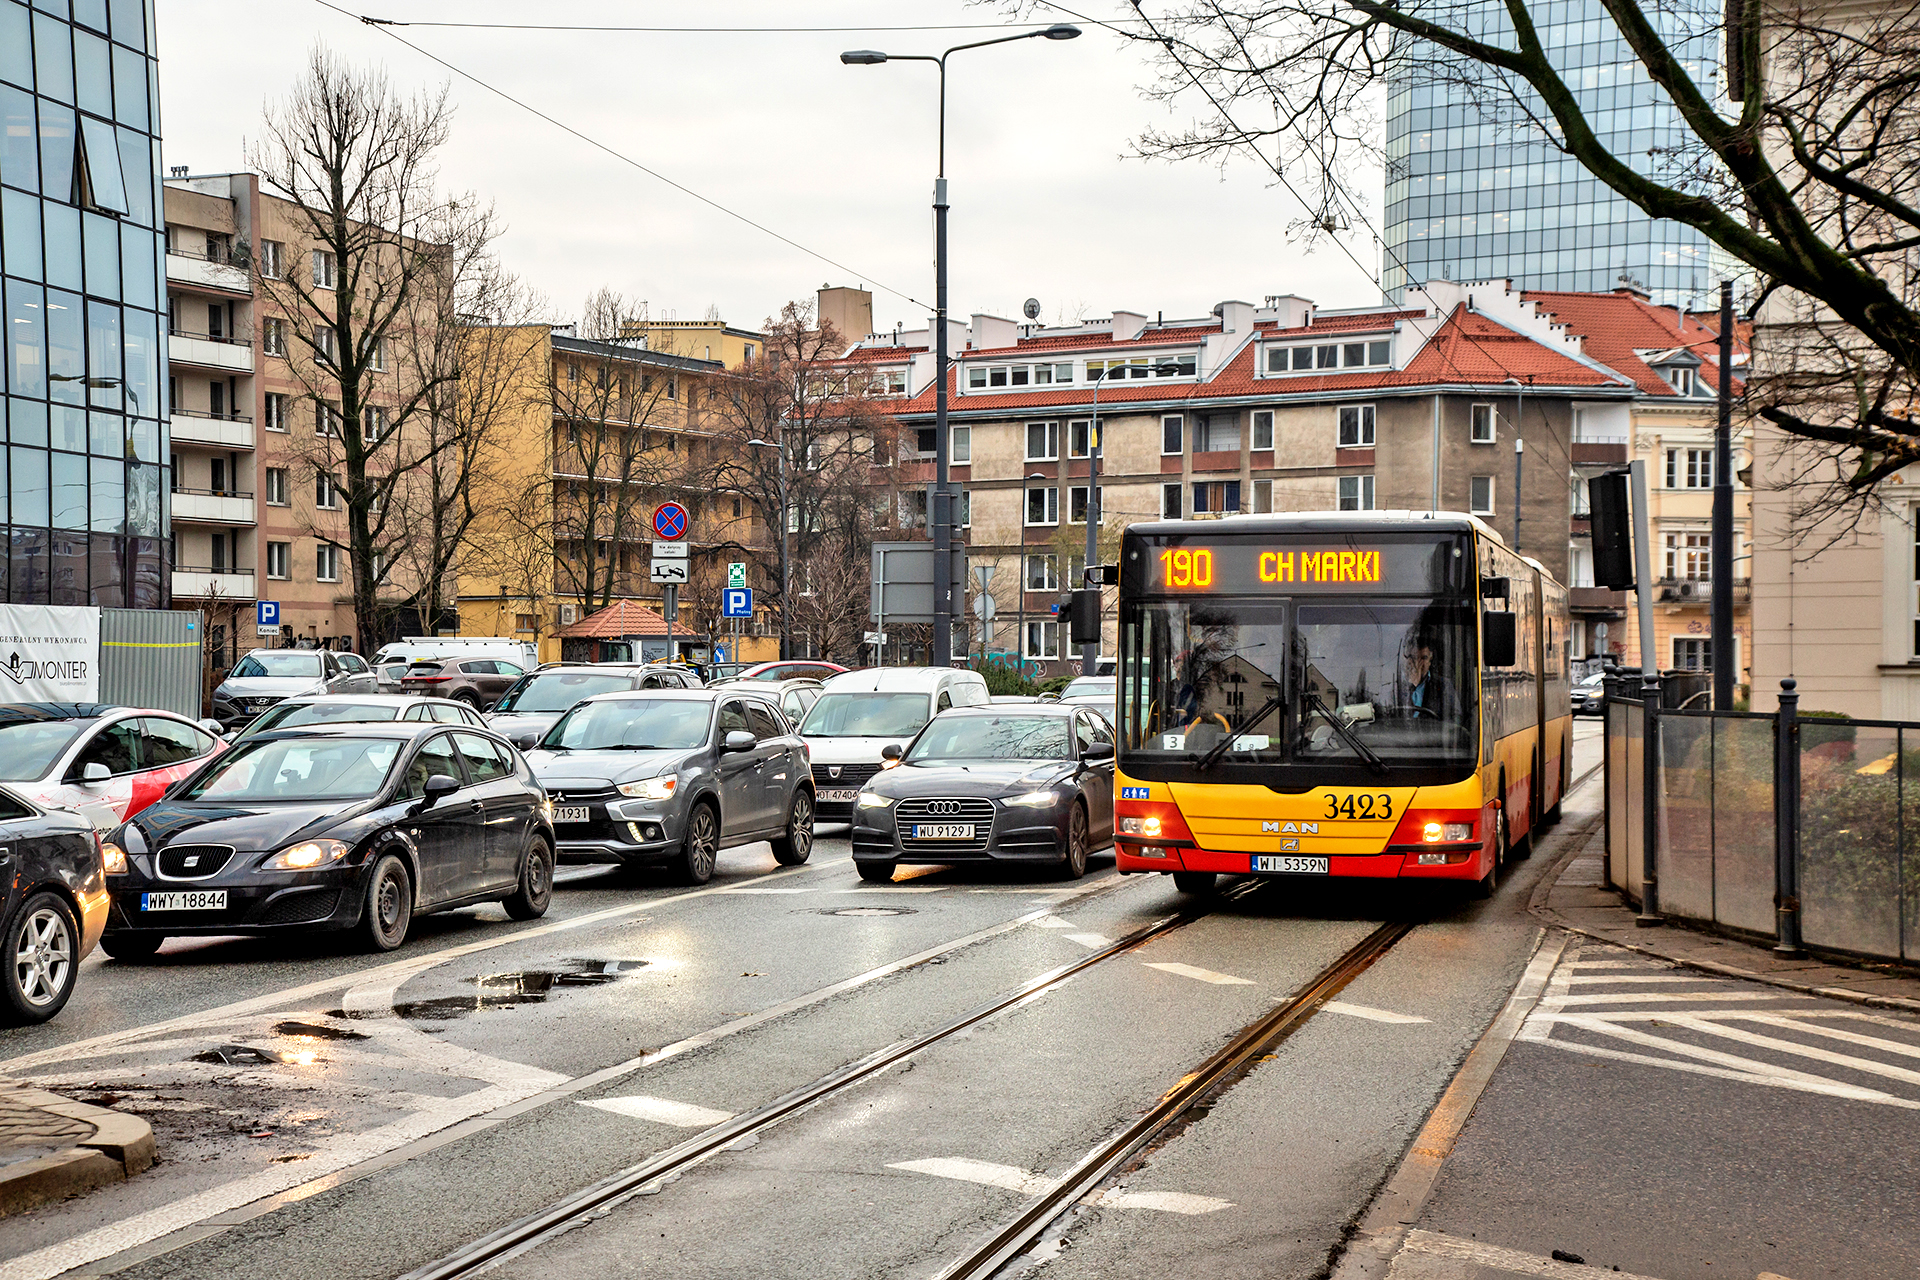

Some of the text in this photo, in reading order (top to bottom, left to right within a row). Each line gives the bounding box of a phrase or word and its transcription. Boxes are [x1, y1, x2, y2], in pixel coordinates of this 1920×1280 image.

[1159, 549, 1212, 586] 190
[1259, 551, 1380, 582] CH MARKI
[729, 591, 746, 614] P
[262, 603, 275, 622] P
[259, 626, 278, 634] Koniec
[0, 635, 88, 645] GENERALNY WYKONAWCA
[33, 661, 88, 680] MONTER
[1169, 736, 1178, 749] 3
[553, 807, 587, 819] 71931
[1323, 793, 1393, 820] 3423
[919, 825, 971, 837] WU 9129J
[1261, 821, 1319, 834] MAN
[1259, 857, 1327, 872] WI 5359N
[149, 893, 175, 908] WWY
[182, 892, 225, 908] 18844
